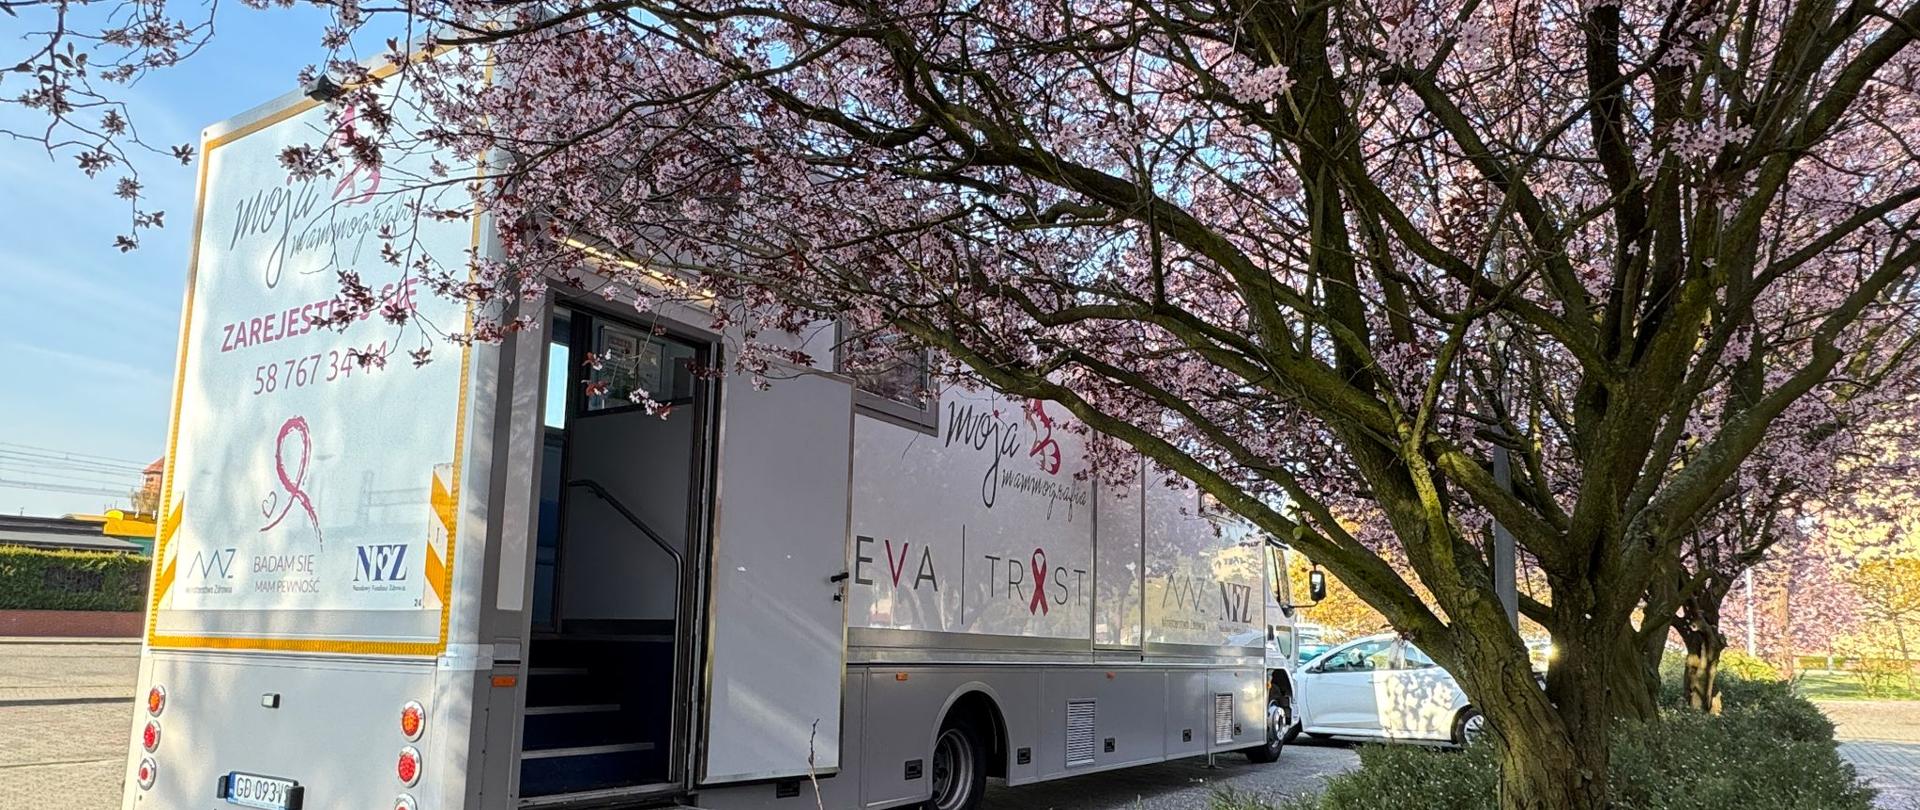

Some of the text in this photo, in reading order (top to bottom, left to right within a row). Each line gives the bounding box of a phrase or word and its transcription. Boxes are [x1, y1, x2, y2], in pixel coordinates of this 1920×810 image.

[230, 175, 319, 289] moja
[290, 192, 417, 265] mammografi
[253, 363, 278, 395] 58
[284, 354, 322, 389] 767
[326, 350, 353, 382] 34
[945, 401, 1020, 508] moja
[1001, 469, 1087, 522] mammografia
[253, 554, 315, 575] BADAM SIĘ
[255, 577, 320, 593] MAM PEWNOŚĆ
[353, 544, 408, 581] NFZ
[855, 535, 938, 592] EVA
[1219, 581, 1252, 623] NFZ
[236, 777, 252, 798] GD
